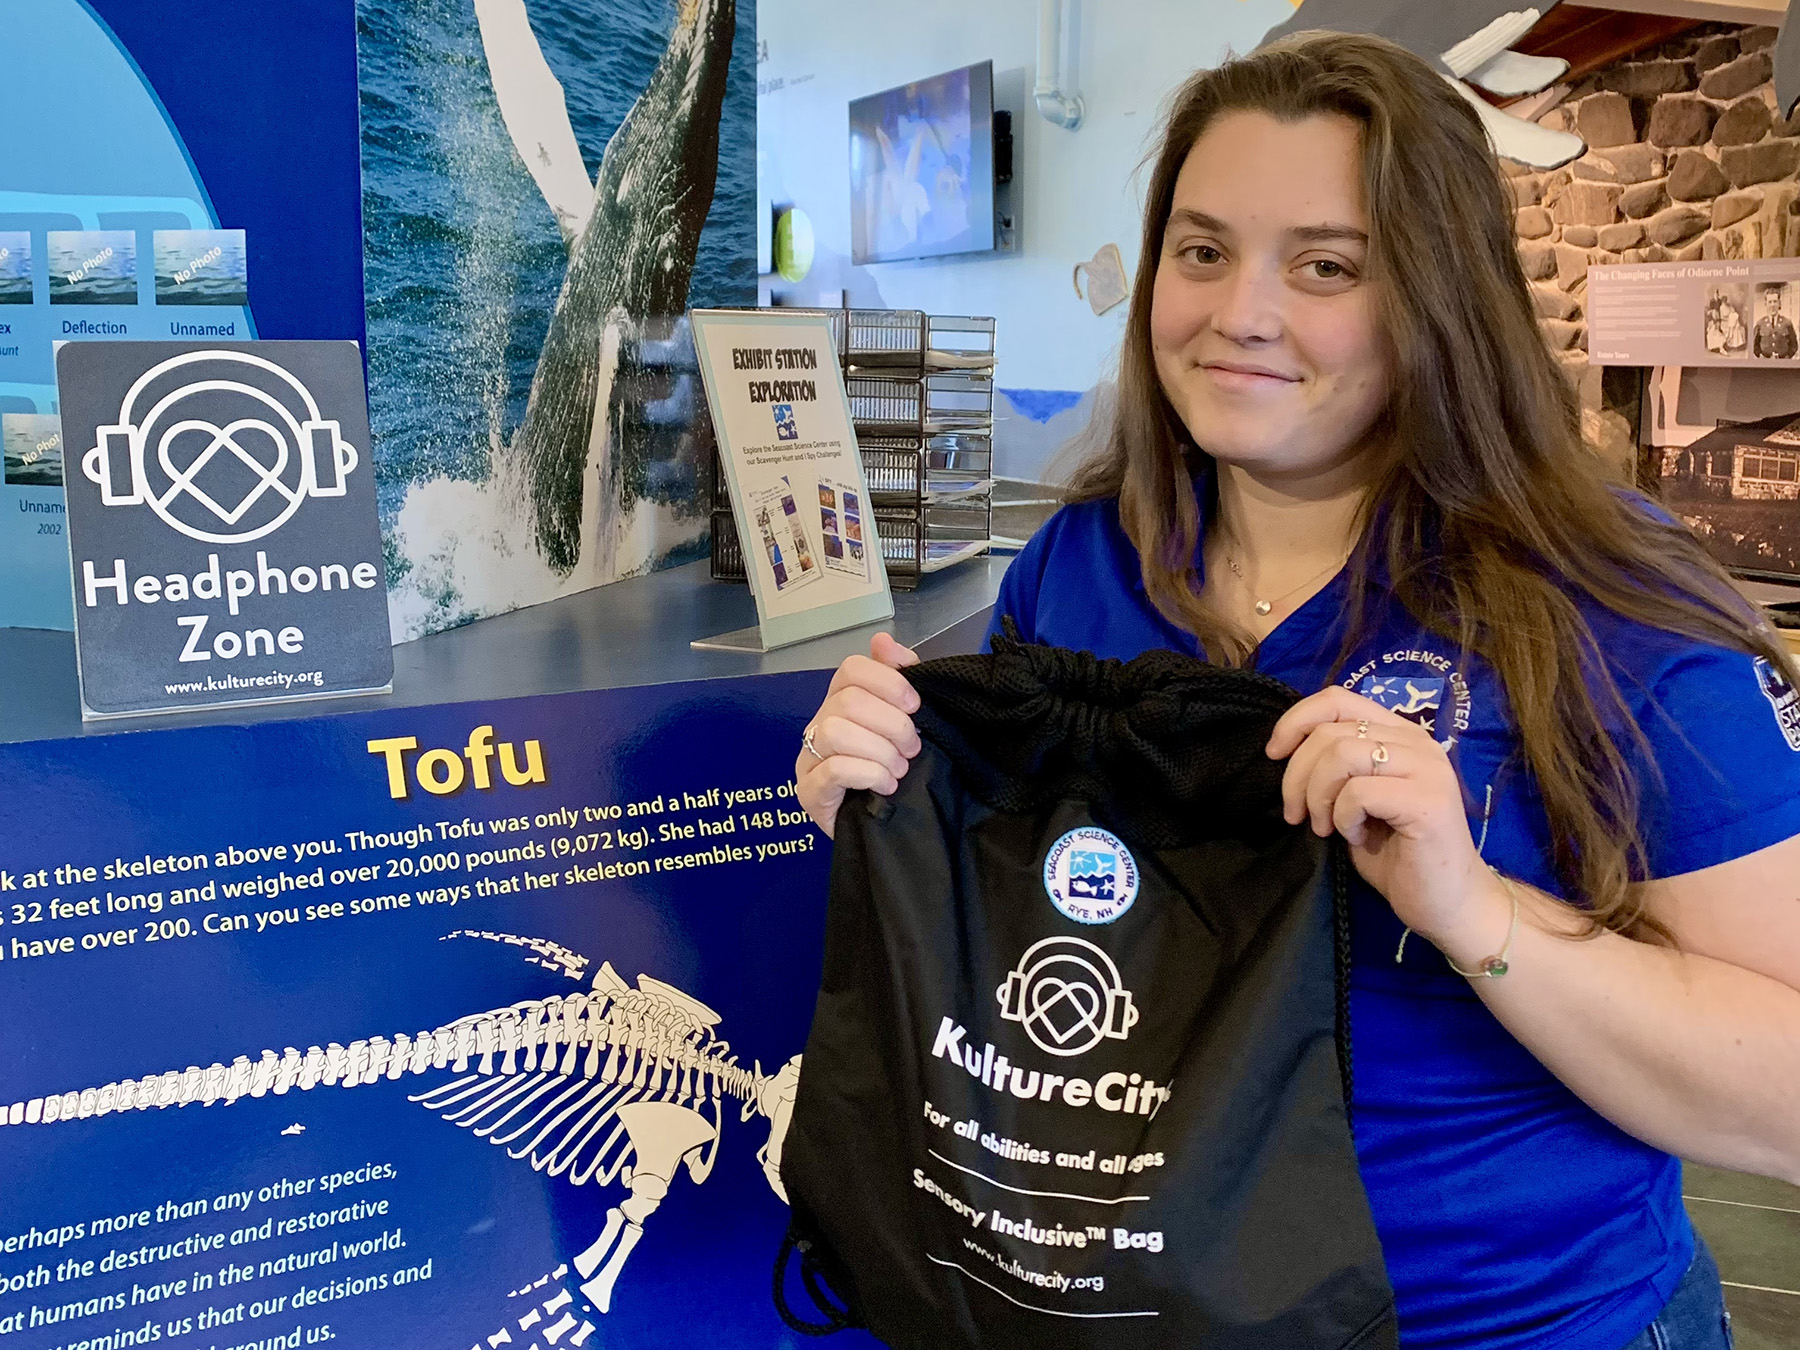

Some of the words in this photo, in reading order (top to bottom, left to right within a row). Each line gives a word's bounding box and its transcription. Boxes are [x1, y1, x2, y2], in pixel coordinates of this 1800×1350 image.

[67, 269, 84, 284] No
[83, 246, 113, 273] Photo
[174, 268, 191, 285] No
[190, 246, 222, 275] Photo
[1611, 269, 1650, 282] Changing
[1652, 268, 1675, 280] Faces
[1677, 267, 1686, 278] of
[1687, 267, 1724, 278] Odiorne
[1726, 265, 1749, 277] Point
[62, 320, 128, 334] Deflection
[170, 322, 235, 336] Unnamed
[0, 346, 19, 356] unt
[732, 348, 773, 370] EXHIBIT
[775, 348, 817, 370] STATION
[748, 379, 817, 403] EXPLORATION
[22, 450, 38, 466] No
[37, 434, 60, 457] Phot
[743, 446, 763, 456] Explore
[763, 445, 771, 453] the
[772, 443, 794, 452] Seacoast
[794, 442, 813, 451] Science
[813, 440, 828, 449] Center
[756, 456, 782, 465] Scavenger
[782, 454, 794, 462] Hunt
[794, 453, 804, 461] and
[807, 451, 816, 461] Spy
[37, 523, 62, 535] 2002
[83, 551, 377, 615] Headphone
[177, 616, 304, 662] Zone
[165, 670, 324, 695] www.kulturecity.org
[1343, 660, 1377, 689] OAST
[1383, 650, 1452, 672] SCIENCE
[1448, 672, 1472, 731] CENTER
[366, 725, 545, 800] Tofu
[23, 870, 48, 889] at
[54, 864, 96, 885] the
[104, 855, 208, 880] skeleton
[215, 846, 287, 867] above
[292, 840, 343, 862] you.
[345, 824, 432, 850] Though
[435, 818, 484, 840] Tofu
[489, 817, 530, 833] was
[535, 807, 579, 828] only
[583, 806, 622, 822] two
[628, 796, 664, 816] and
[669, 798, 680, 811] a
[684, 788, 720, 809] half
[724, 787, 773, 809] years
[1048, 835, 1076, 880] SEACOAST
[1078, 830, 1119, 850] SCIENCE
[1119, 850, 1135, 888] CENTER
[11, 903, 43, 924] 32
[49, 897, 101, 920] feet
[107, 892, 163, 913] long
[170, 881, 216, 905] and
[222, 868, 324, 898] weighed
[330, 866, 380, 885] over
[386, 852, 460, 878] 20,000
[466, 841, 546, 872] pounds
[550, 832, 614, 859] (9,072
[618, 826, 656, 850] kg).
[659, 822, 695, 842] She
[698, 815, 736, 837] had
[740, 812, 774, 831] 148
[777, 809, 814, 826] bon
[12, 937, 75, 959] have
[81, 928, 138, 950] over
[144, 918, 197, 942] 200.
[203, 914, 249, 933] Can
[255, 907, 300, 932] you
[305, 903, 345, 921] see
[350, 894, 411, 915] some
[416, 886, 472, 906] ways
[475, 876, 521, 897] that
[525, 872, 560, 889] her
[565, 861, 650, 885] skeleton
[655, 845, 752, 871] resembles
[756, 834, 814, 862] yours?
[1096, 907, 1114, 919] NH
[924, 1101, 950, 1128] For
[953, 1119, 979, 1142] all
[981, 1133, 1051, 1165] abilities
[1055, 1150, 1096, 1171] and
[1099, 1154, 1127, 1175] all
[0, 1224, 85, 1253] erhaps
[91, 1211, 150, 1236] more
[156, 1200, 208, 1223] than
[213, 1188, 254, 1212] any
[258, 1178, 315, 1202] other
[320, 1162, 397, 1194] species,
[914, 1169, 986, 1228] Sensory
[1113, 1227, 1164, 1252] Bag
[57, 1259, 95, 1282] the
[100, 1234, 224, 1273] destructive
[229, 1224, 272, 1246] and
[277, 1199, 389, 1236] restorative
[30, 1293, 126, 1328] humans
[132, 1280, 187, 1306] have
[192, 1272, 213, 1293] in
[219, 1264, 254, 1287] the
[259, 1246, 338, 1278] natural
[343, 1229, 407, 1260] world.
[963, 1237, 1104, 1293] www.kulturecity.org
[168, 1317, 192, 1337] us
[198, 1303, 245, 1330] that
[249, 1295, 288, 1318] our
[292, 1274, 388, 1309] decisions
[393, 1258, 432, 1286] and
[306, 1324, 336, 1344] us.
